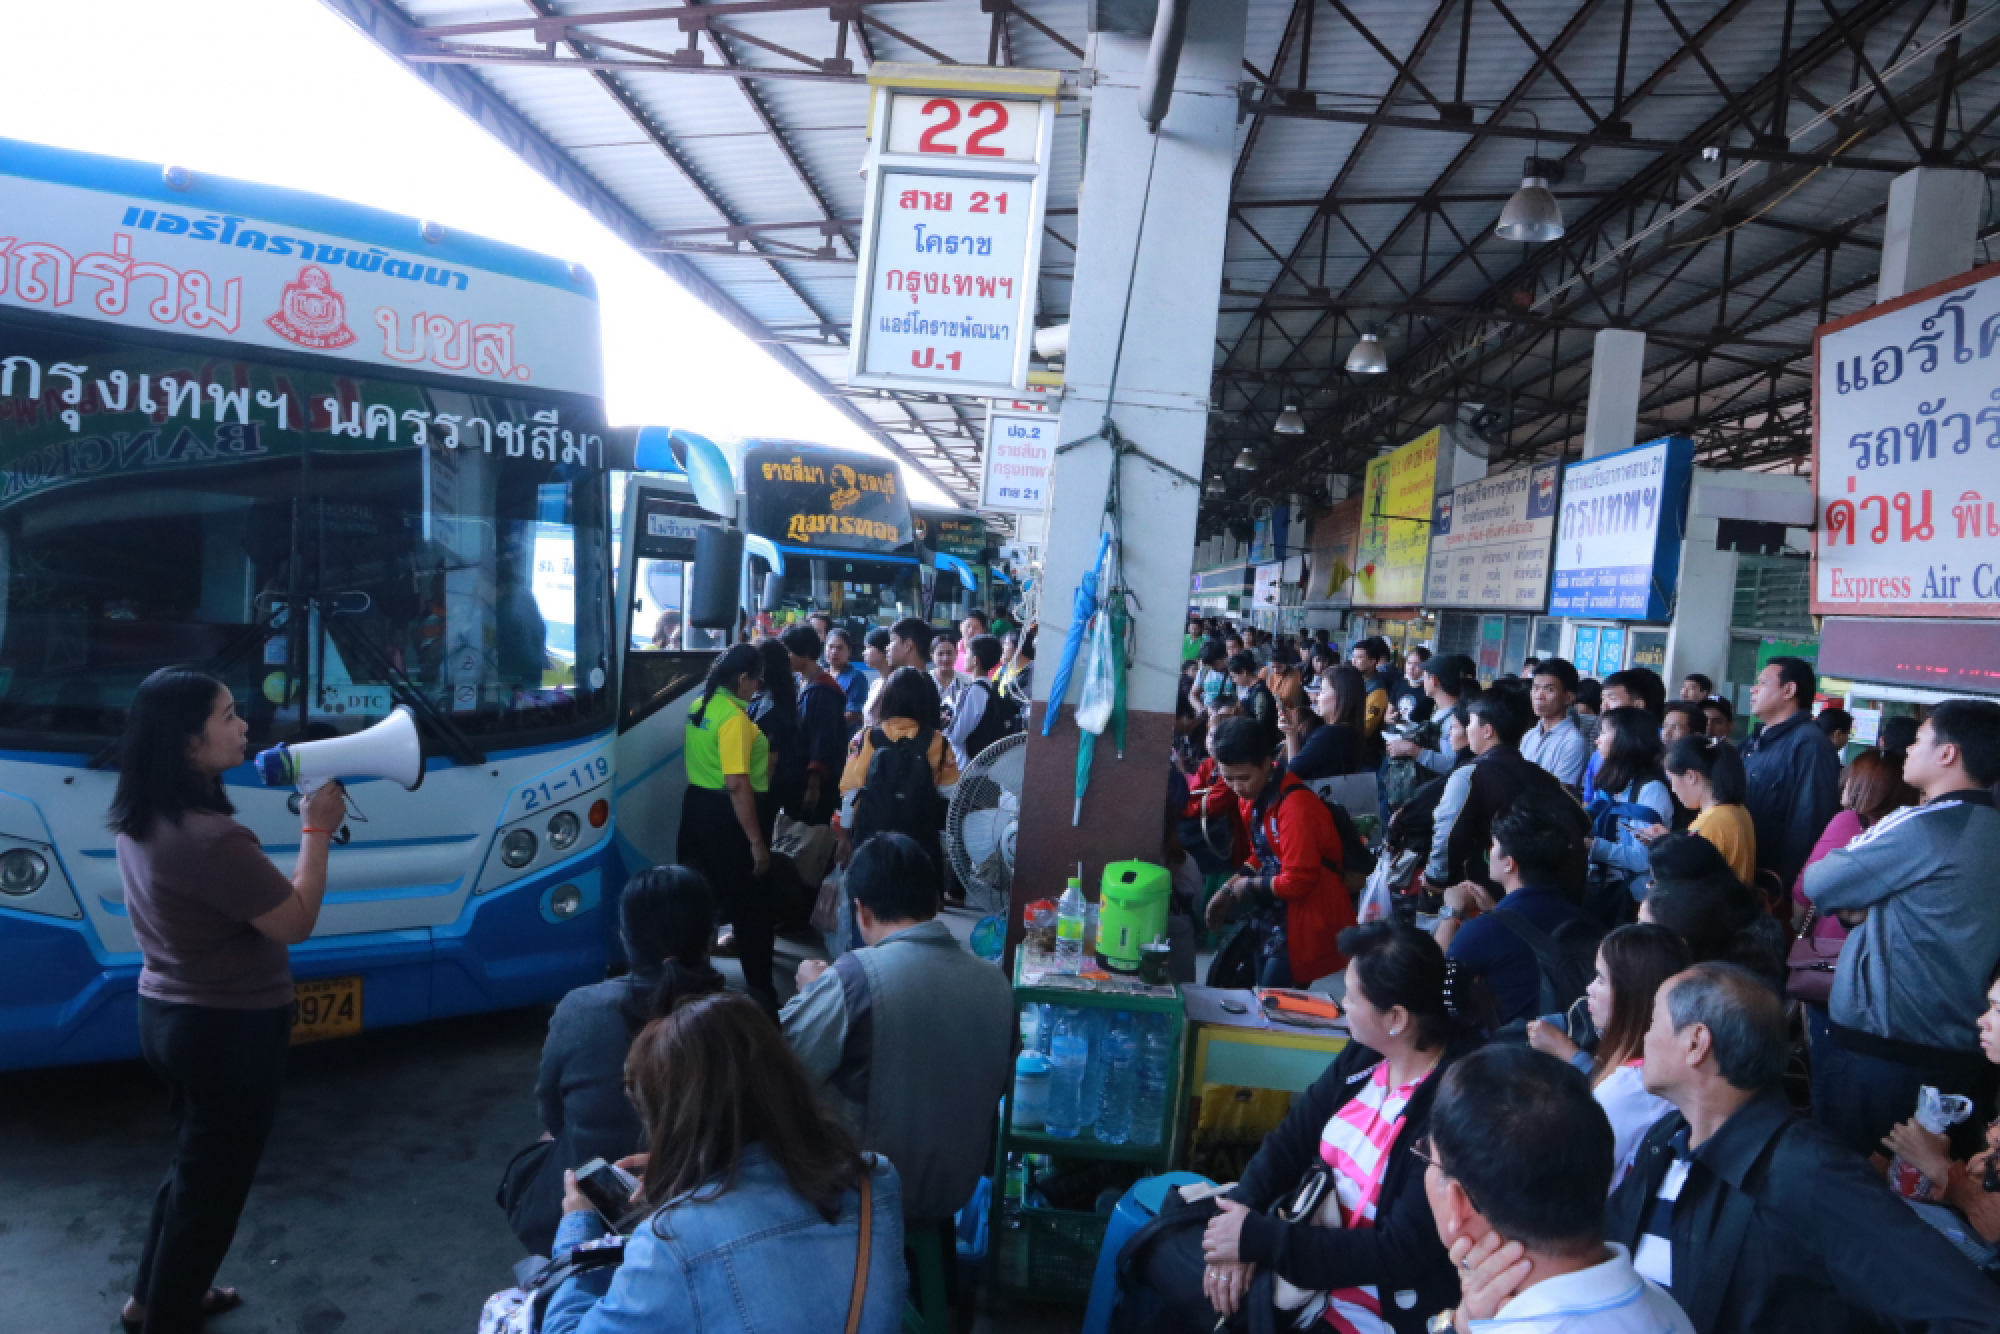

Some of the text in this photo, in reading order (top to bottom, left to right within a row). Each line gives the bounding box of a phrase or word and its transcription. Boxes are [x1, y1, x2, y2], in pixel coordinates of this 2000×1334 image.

[918, 97, 1010, 156] 22
[899, 190, 1009, 214] สาย 21
[121, 205, 469, 291] แอร์โคราชพัฒนา
[913, 223, 993, 256] โคราช
[886, 269, 1014, 304] กรุงเทพฯ
[880, 309, 1010, 341] แอร์โคราชพัฒนา
[911, 347, 963, 371] ป.1
[0, 355, 604, 469] กรุงเทพฯ นครราชสีมา
[1825, 476, 1935, 547] ด่วน
[1830, 567, 1912, 603] Express
[1920, 563, 1961, 599] Air
[347, 694, 383, 709] DTC
[521, 755, 609, 811] 21-119
